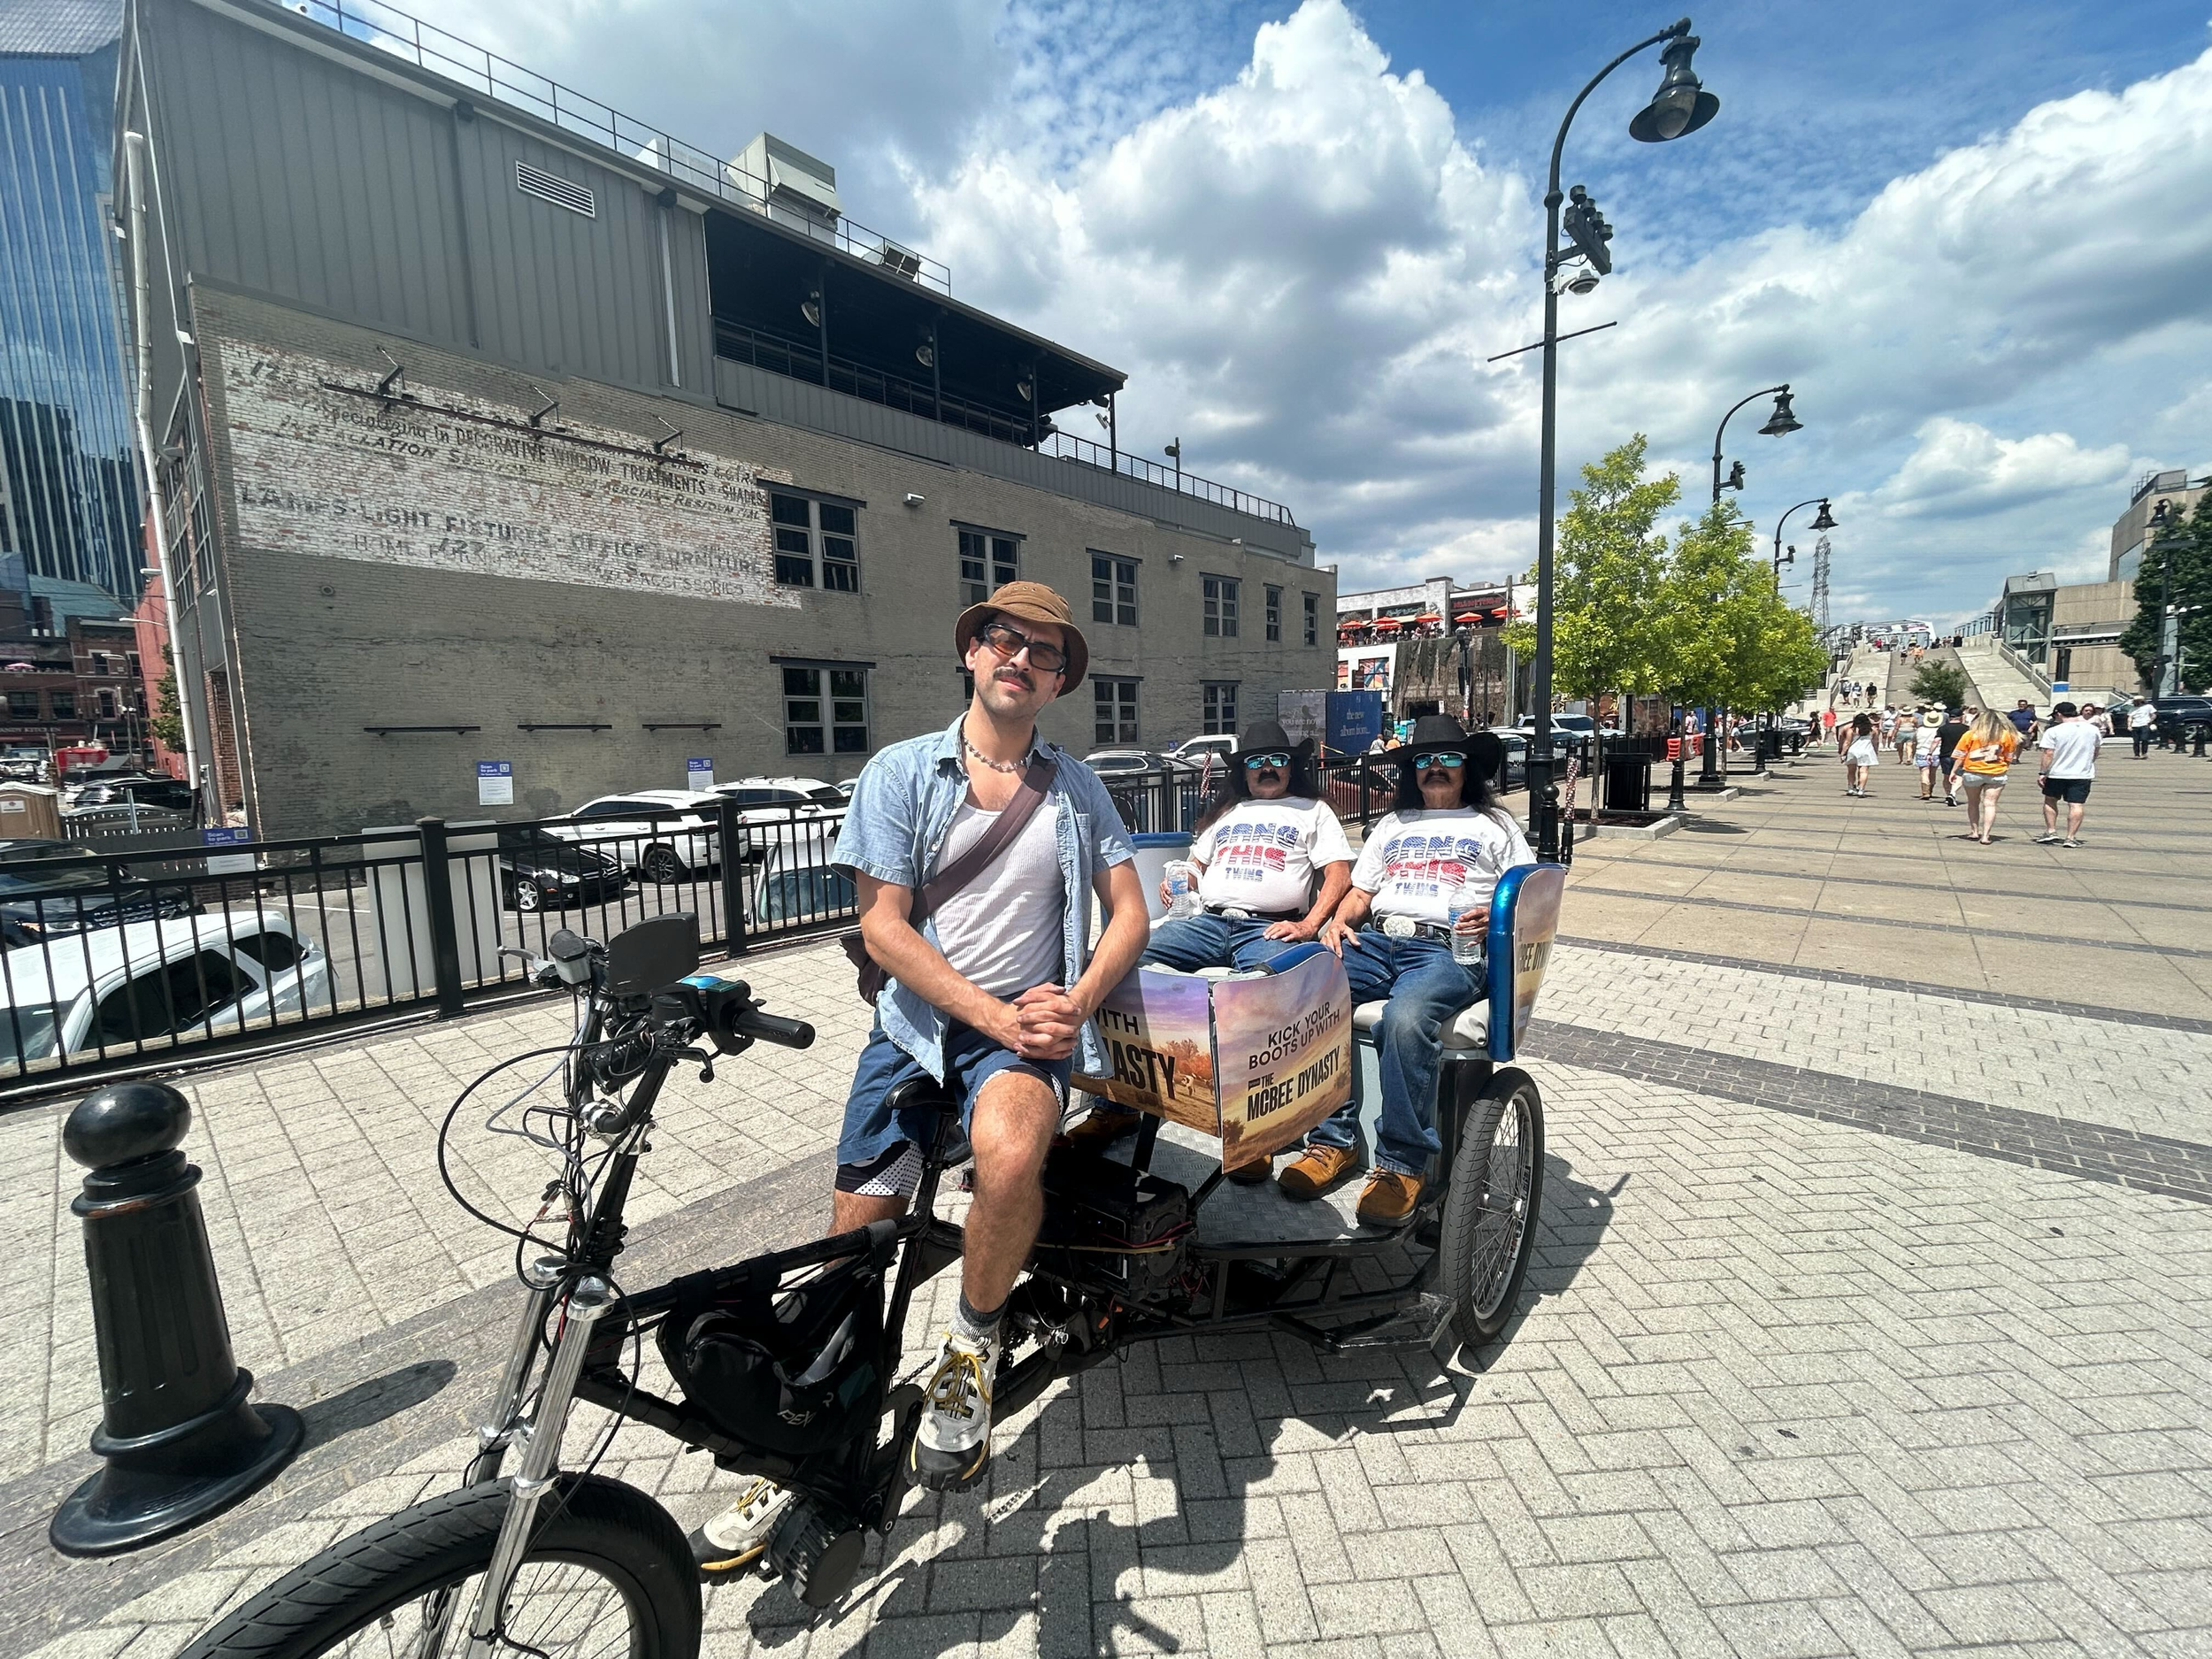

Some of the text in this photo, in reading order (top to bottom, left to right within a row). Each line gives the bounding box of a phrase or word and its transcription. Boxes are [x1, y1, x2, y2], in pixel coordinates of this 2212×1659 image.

[455, 427, 547, 464] DECORATIVE
[622, 463, 706, 495] TREATMENTS
[1214, 845, 1286, 872] THIS
[1225, 867, 1263, 883] TWINS
[1386, 859, 1467, 887] THIS
[1394, 882, 1439, 897] TWINS
[1268, 1001, 1330, 1048] KICK YOUR
[1248, 1009, 1340, 1070] BOOTS UP WITH
[1247, 1045, 1340, 1122] MCBEE DYNASTY
[1262, 1072, 1274, 1088] THE
